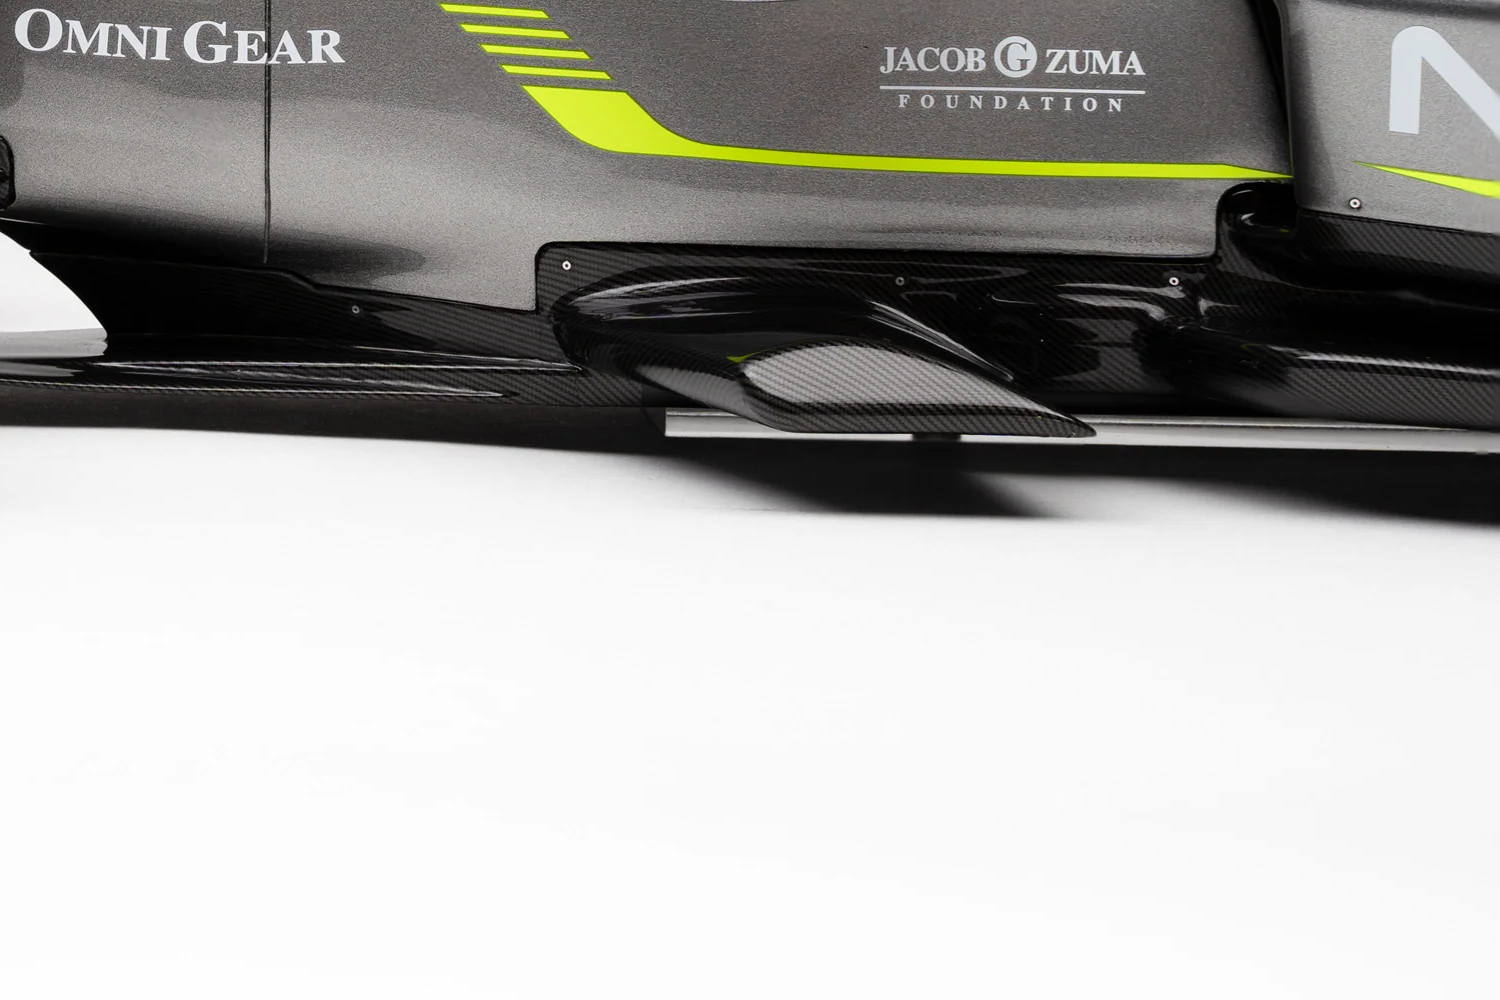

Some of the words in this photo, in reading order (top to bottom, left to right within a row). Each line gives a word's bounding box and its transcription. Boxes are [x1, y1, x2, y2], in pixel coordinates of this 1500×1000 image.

[13, 7, 173, 62] OMNI
[182, 19, 347, 66] GEAR
[879, 46, 987, 75] JACOB
[1044, 48, 1146, 76] ZUMA
[897, 93, 1124, 113] FOUNDATION
